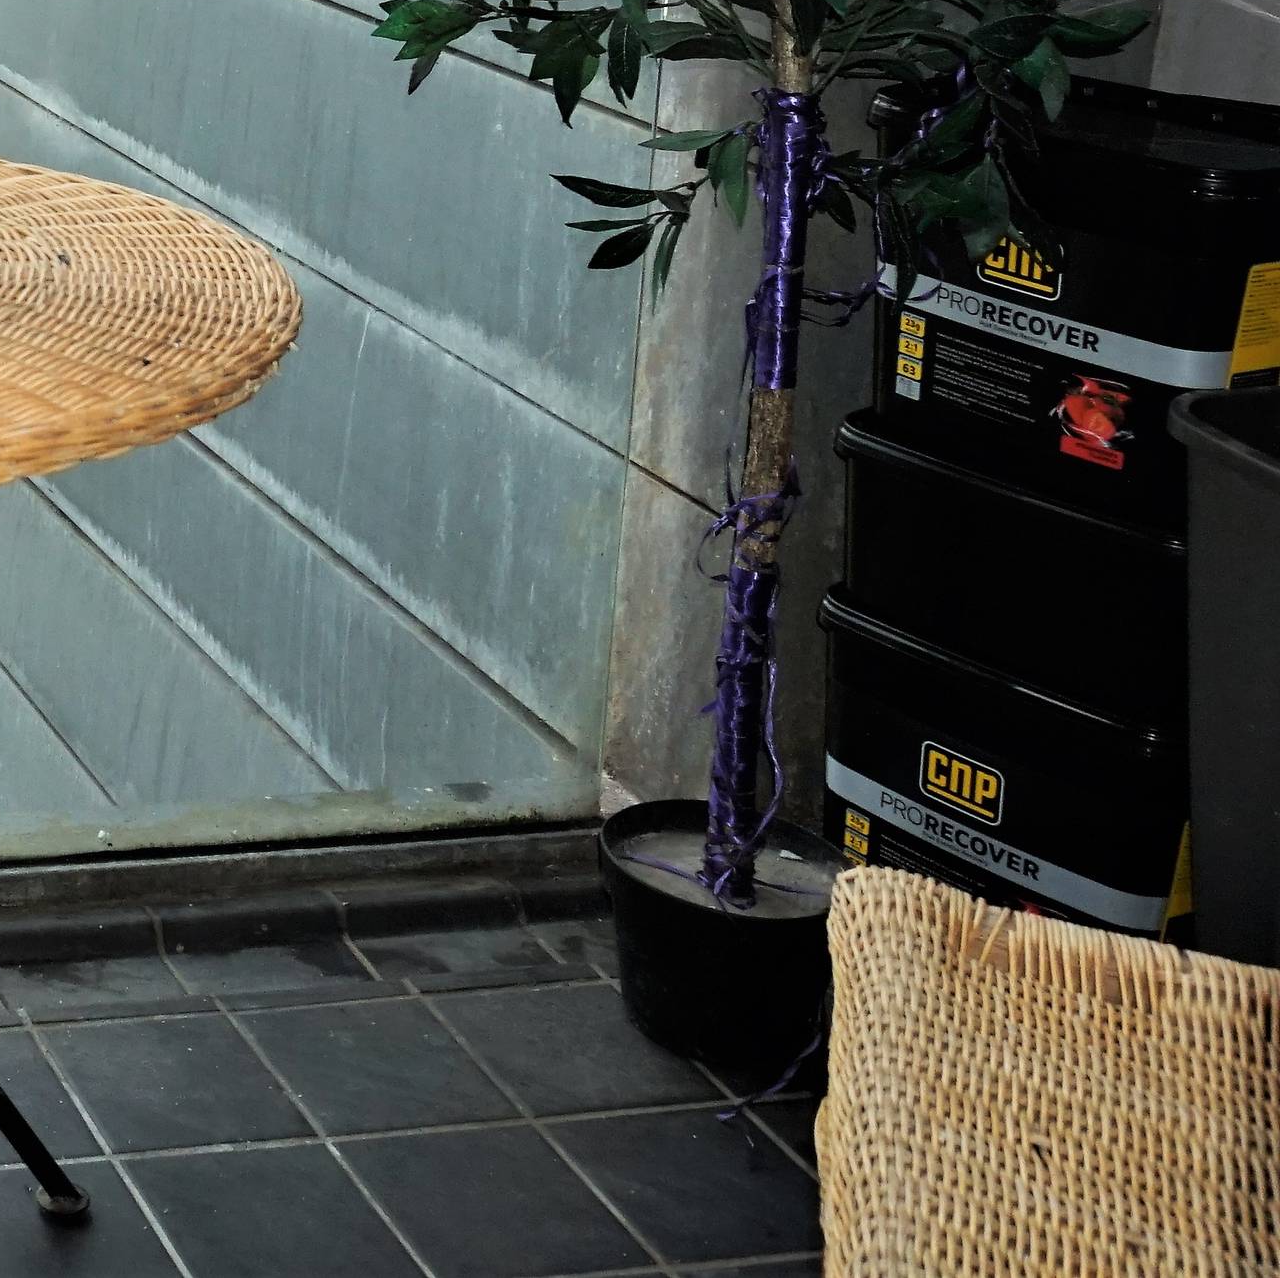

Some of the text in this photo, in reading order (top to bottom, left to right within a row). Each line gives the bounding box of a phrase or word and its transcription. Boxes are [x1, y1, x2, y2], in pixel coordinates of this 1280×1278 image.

[902, 363, 916, 376] 63
[927, 750, 998, 805] CNP
[880, 791, 1040, 881] PRORECOVER
